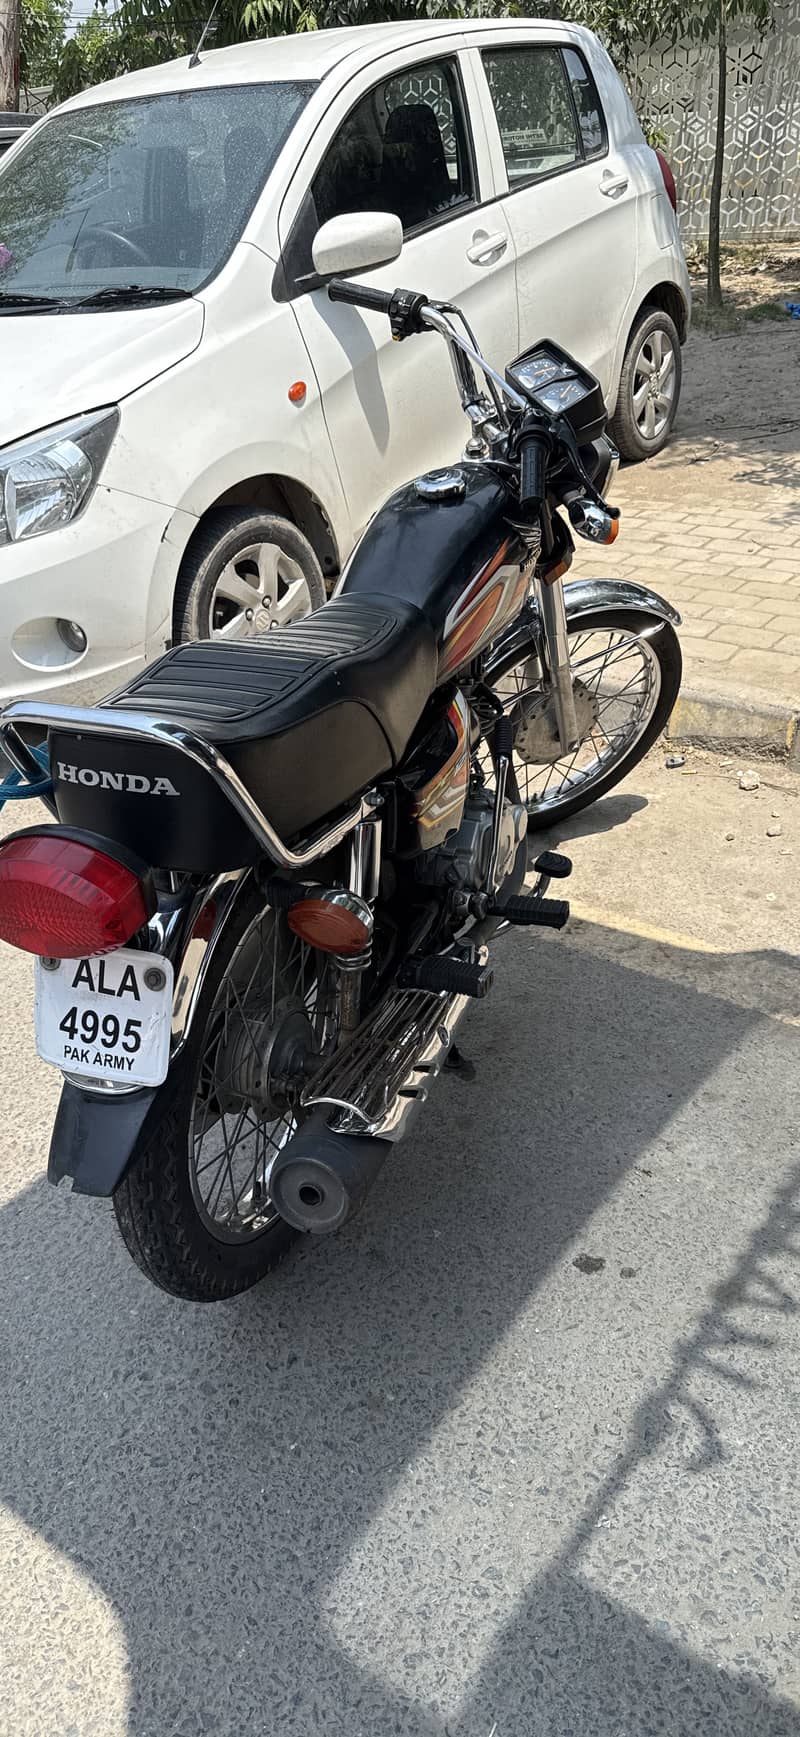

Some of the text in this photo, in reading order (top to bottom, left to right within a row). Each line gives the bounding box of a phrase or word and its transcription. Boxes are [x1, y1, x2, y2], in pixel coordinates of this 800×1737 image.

[57, 761, 180, 796] HONDA
[71, 959, 141, 1002] ALA
[59, 1006, 142, 1053] 4995
[64, 1045, 135, 1071] PAK ARMY
